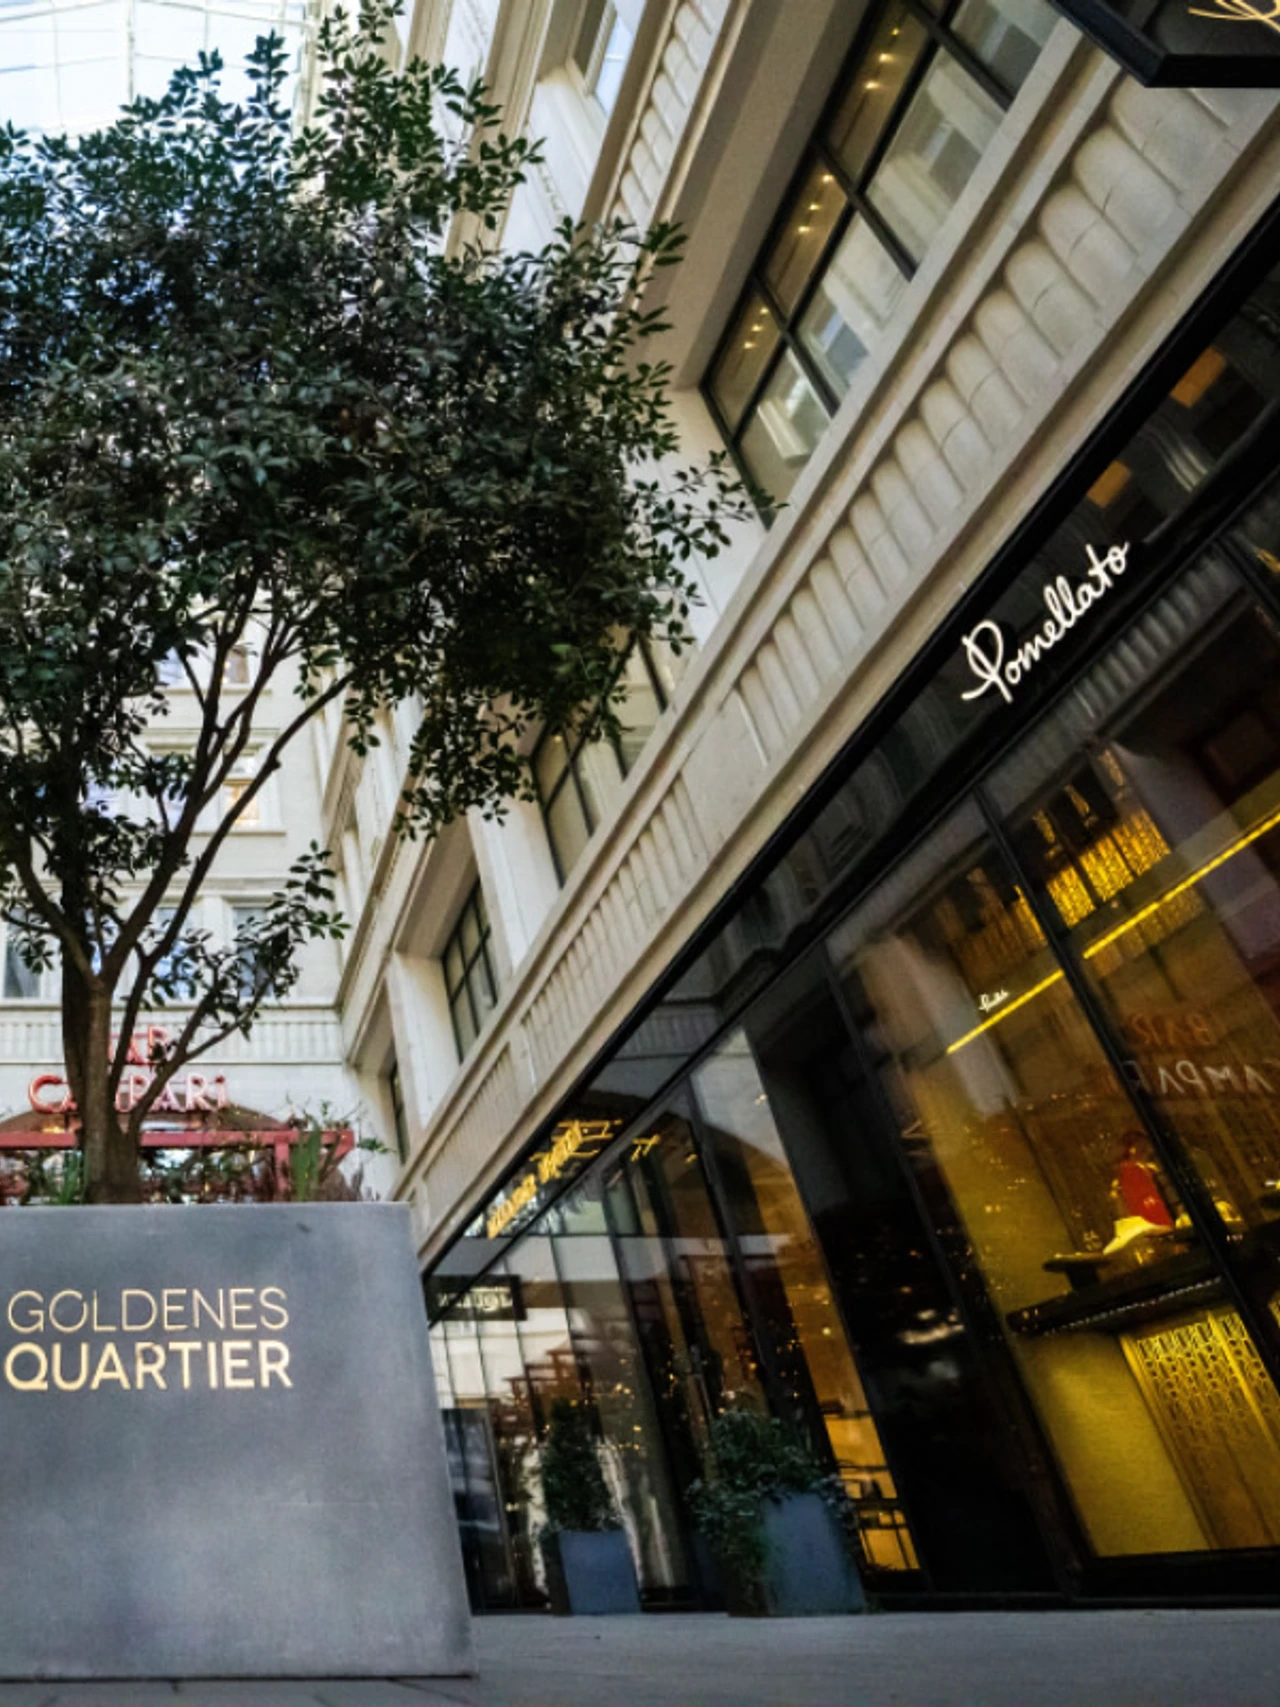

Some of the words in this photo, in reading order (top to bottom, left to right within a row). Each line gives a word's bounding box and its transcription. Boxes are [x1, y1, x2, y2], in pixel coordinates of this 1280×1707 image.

[961, 541, 1130, 703] Pomellato
[27, 1073, 229, 1113] CPARI
[7, 1286, 290, 1334] GOLDENES
[3, 1338, 294, 1392] QUARTIER
